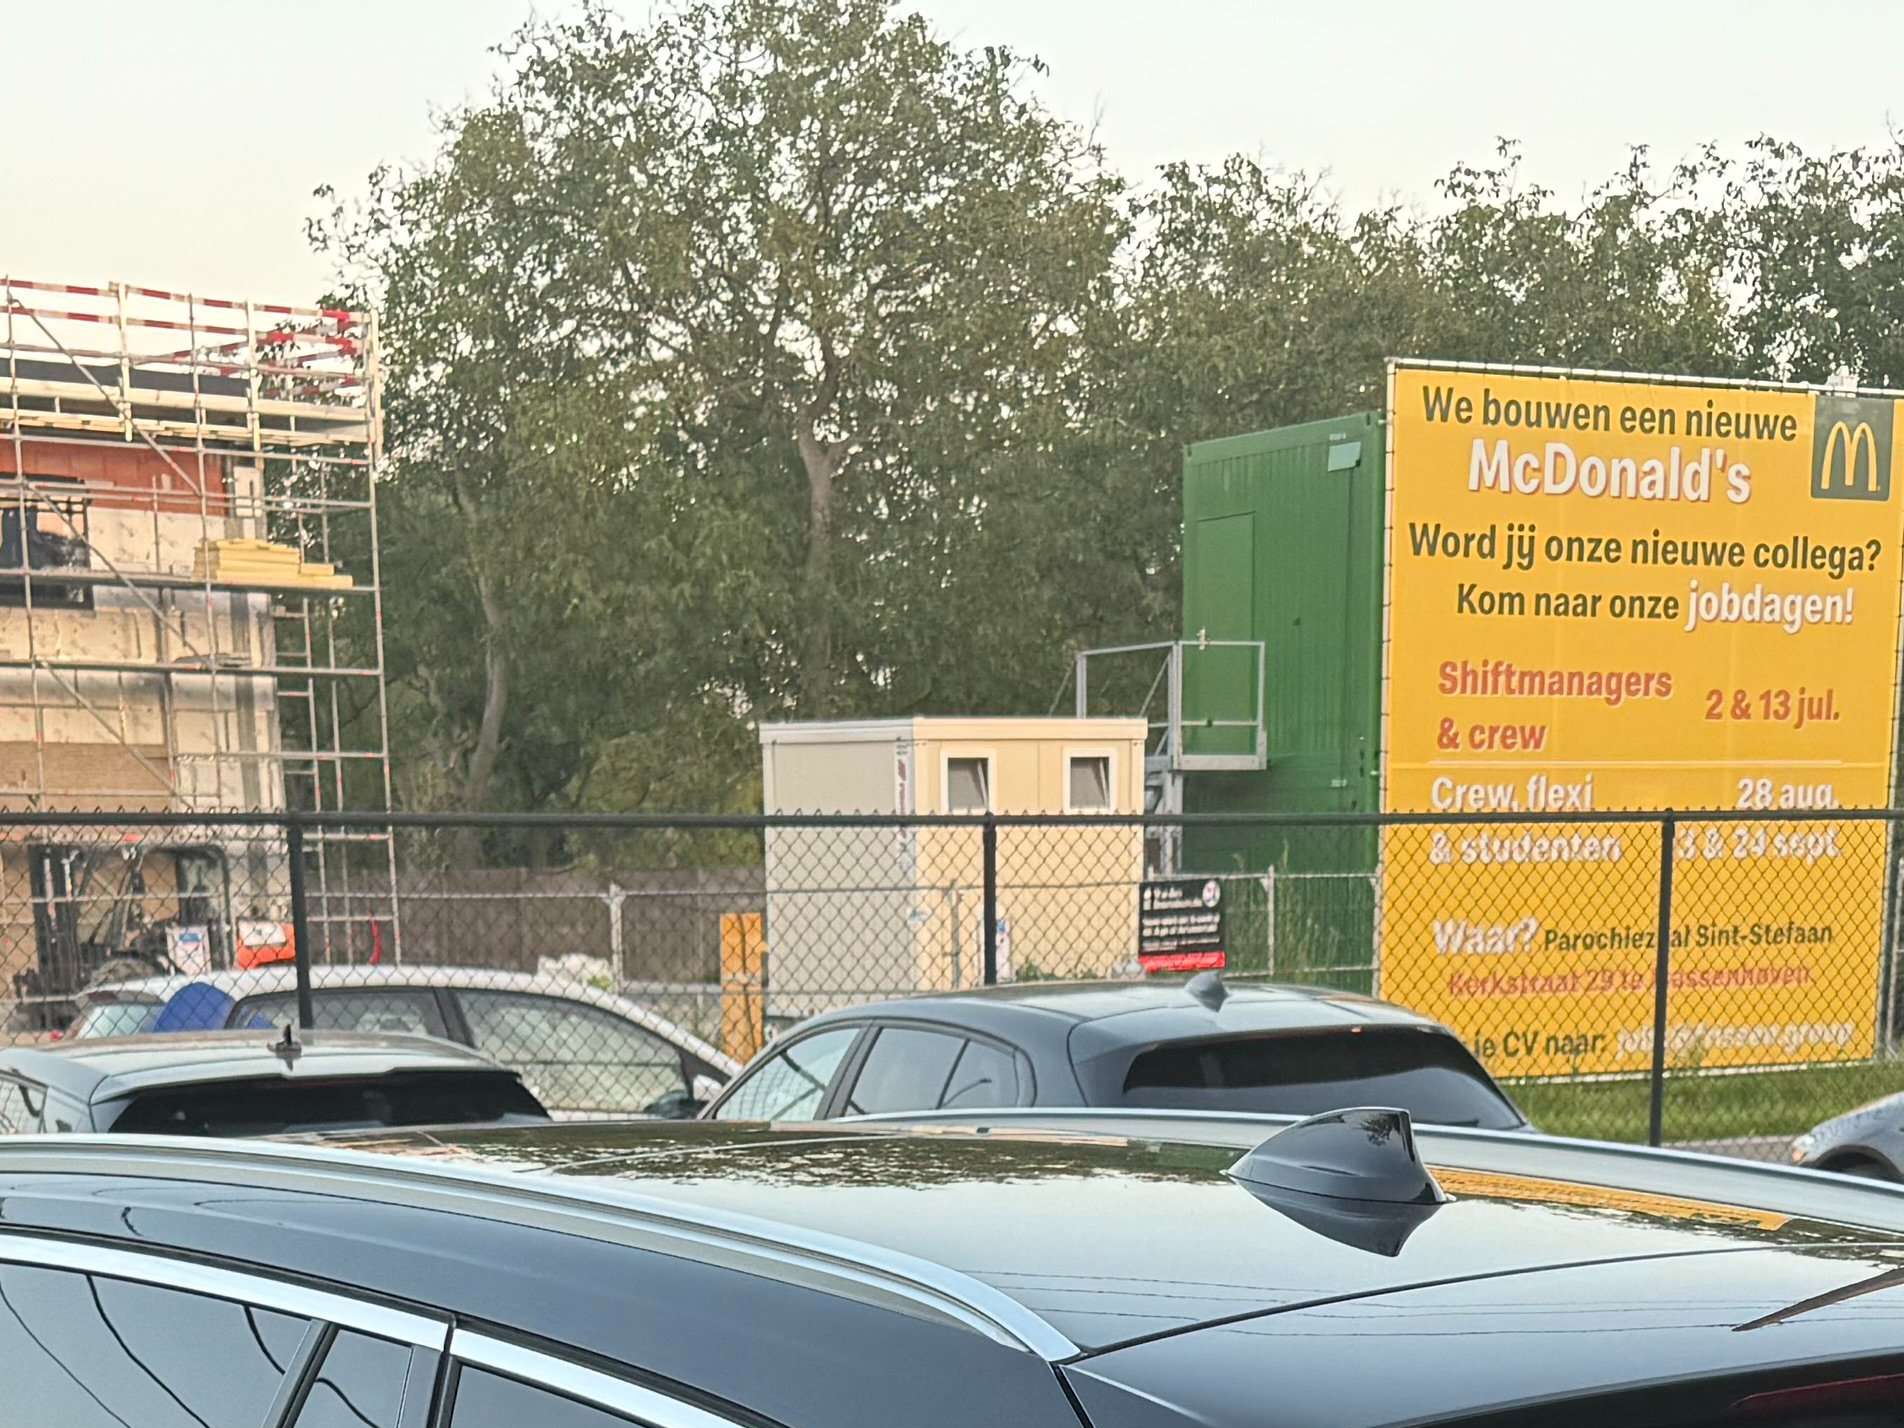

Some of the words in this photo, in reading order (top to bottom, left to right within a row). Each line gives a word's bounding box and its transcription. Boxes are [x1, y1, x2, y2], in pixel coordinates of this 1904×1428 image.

[1423, 385, 1473, 424] We
[1483, 388, 1611, 432] bouwen
[1619, 405, 1677, 435] een
[1685, 399, 1798, 441] nieuwe
[1468, 438, 1753, 504] McDonald's
[1409, 523, 1497, 560] Word
[1502, 523, 1537, 571] jij
[1544, 534, 1622, 564] onze
[1631, 529, 1746, 569] nieuwe
[1753, 535, 1882, 580] collega?
[1457, 583, 1525, 617] Kom
[1534, 592, 1602, 619] naar
[1610, 592, 1679, 620] onze
[1684, 579, 1855, 634] jobdagen!
[1437, 659, 1673, 707] Shiftmanagers
[1705, 689, 1724, 721] 2
[1729, 689, 1753, 721] &
[1759, 688, 1792, 721] 13
[1794, 686, 1841, 730] jul.
[1437, 717, 1461, 751] &
[1468, 722, 1546, 752] crew
[1431, 776, 1520, 812] Crew,
[1527, 772, 1595, 811] flexi
[1737, 777, 1772, 810] 28
[1429, 831, 1455, 865] &
[1461, 830, 1623, 865] studenten
[1703, 827, 1724, 861] &
[1733, 826, 1766, 860] 24
[1432, 916, 1539, 957] Waar?
[1544, 923, 1690, 953] Parochiezal
[1696, 921, 1833, 949] Sint-Stefaan
[1501, 1030, 1539, 1058] CV
